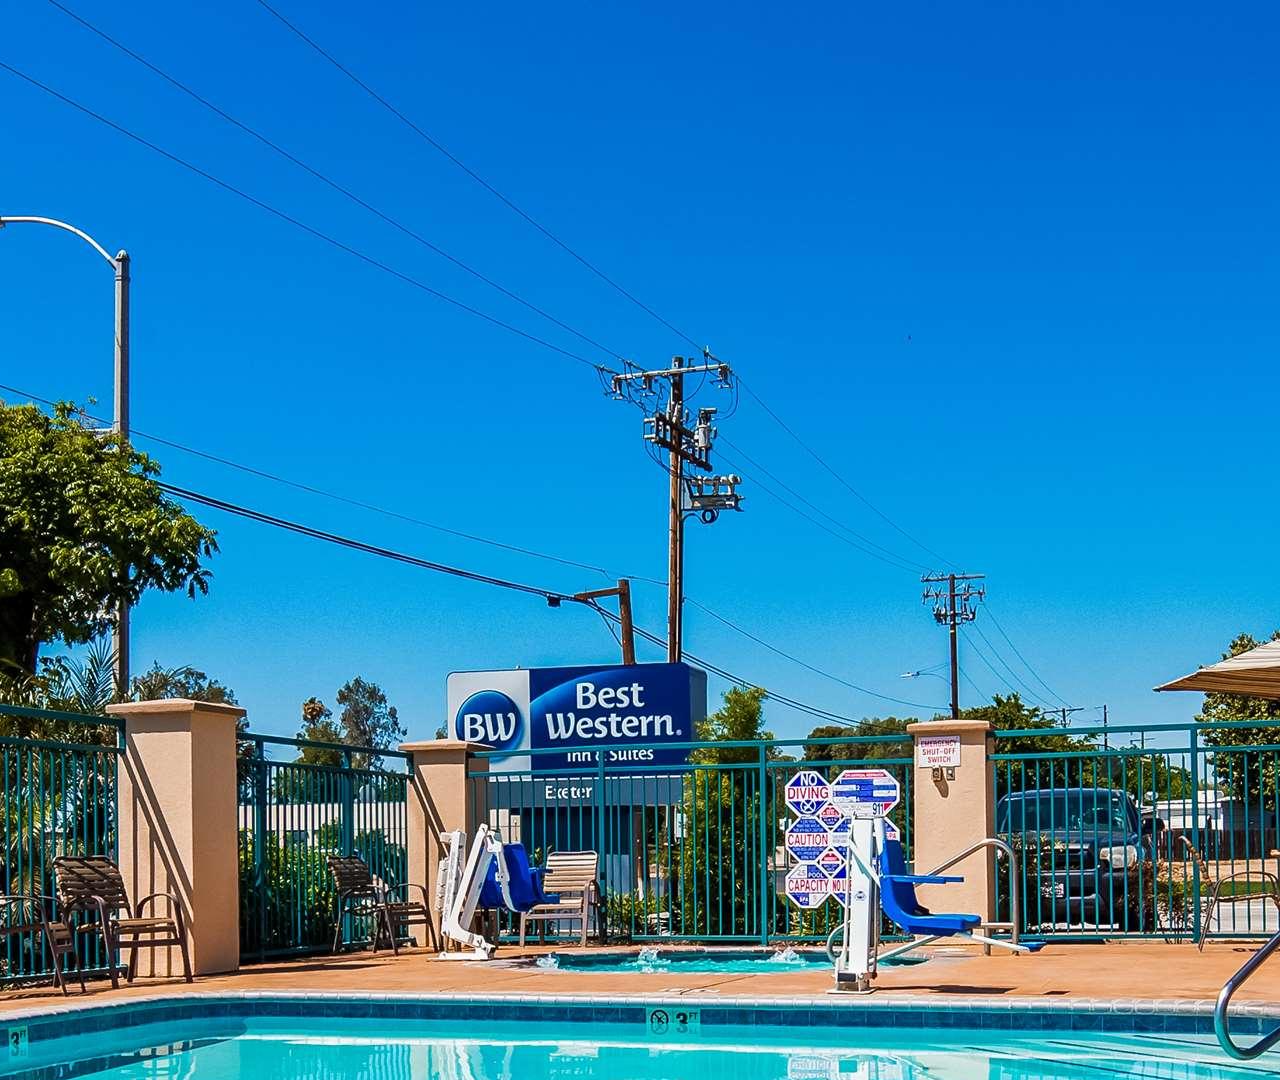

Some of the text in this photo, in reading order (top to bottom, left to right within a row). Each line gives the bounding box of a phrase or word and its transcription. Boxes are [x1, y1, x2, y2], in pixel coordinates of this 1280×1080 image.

[576, 682, 645, 709] Best
[464, 712, 516, 742] BW
[609, 749, 654, 760] Suites
[800, 773, 818, 786] NO
[787, 787, 829, 799] DIVING
[872, 803, 884, 815] 911
[787, 834, 829, 845] CAUTION
[788, 880, 829, 891] CAPACITY
[676, 1012, 688, 1025] 3
